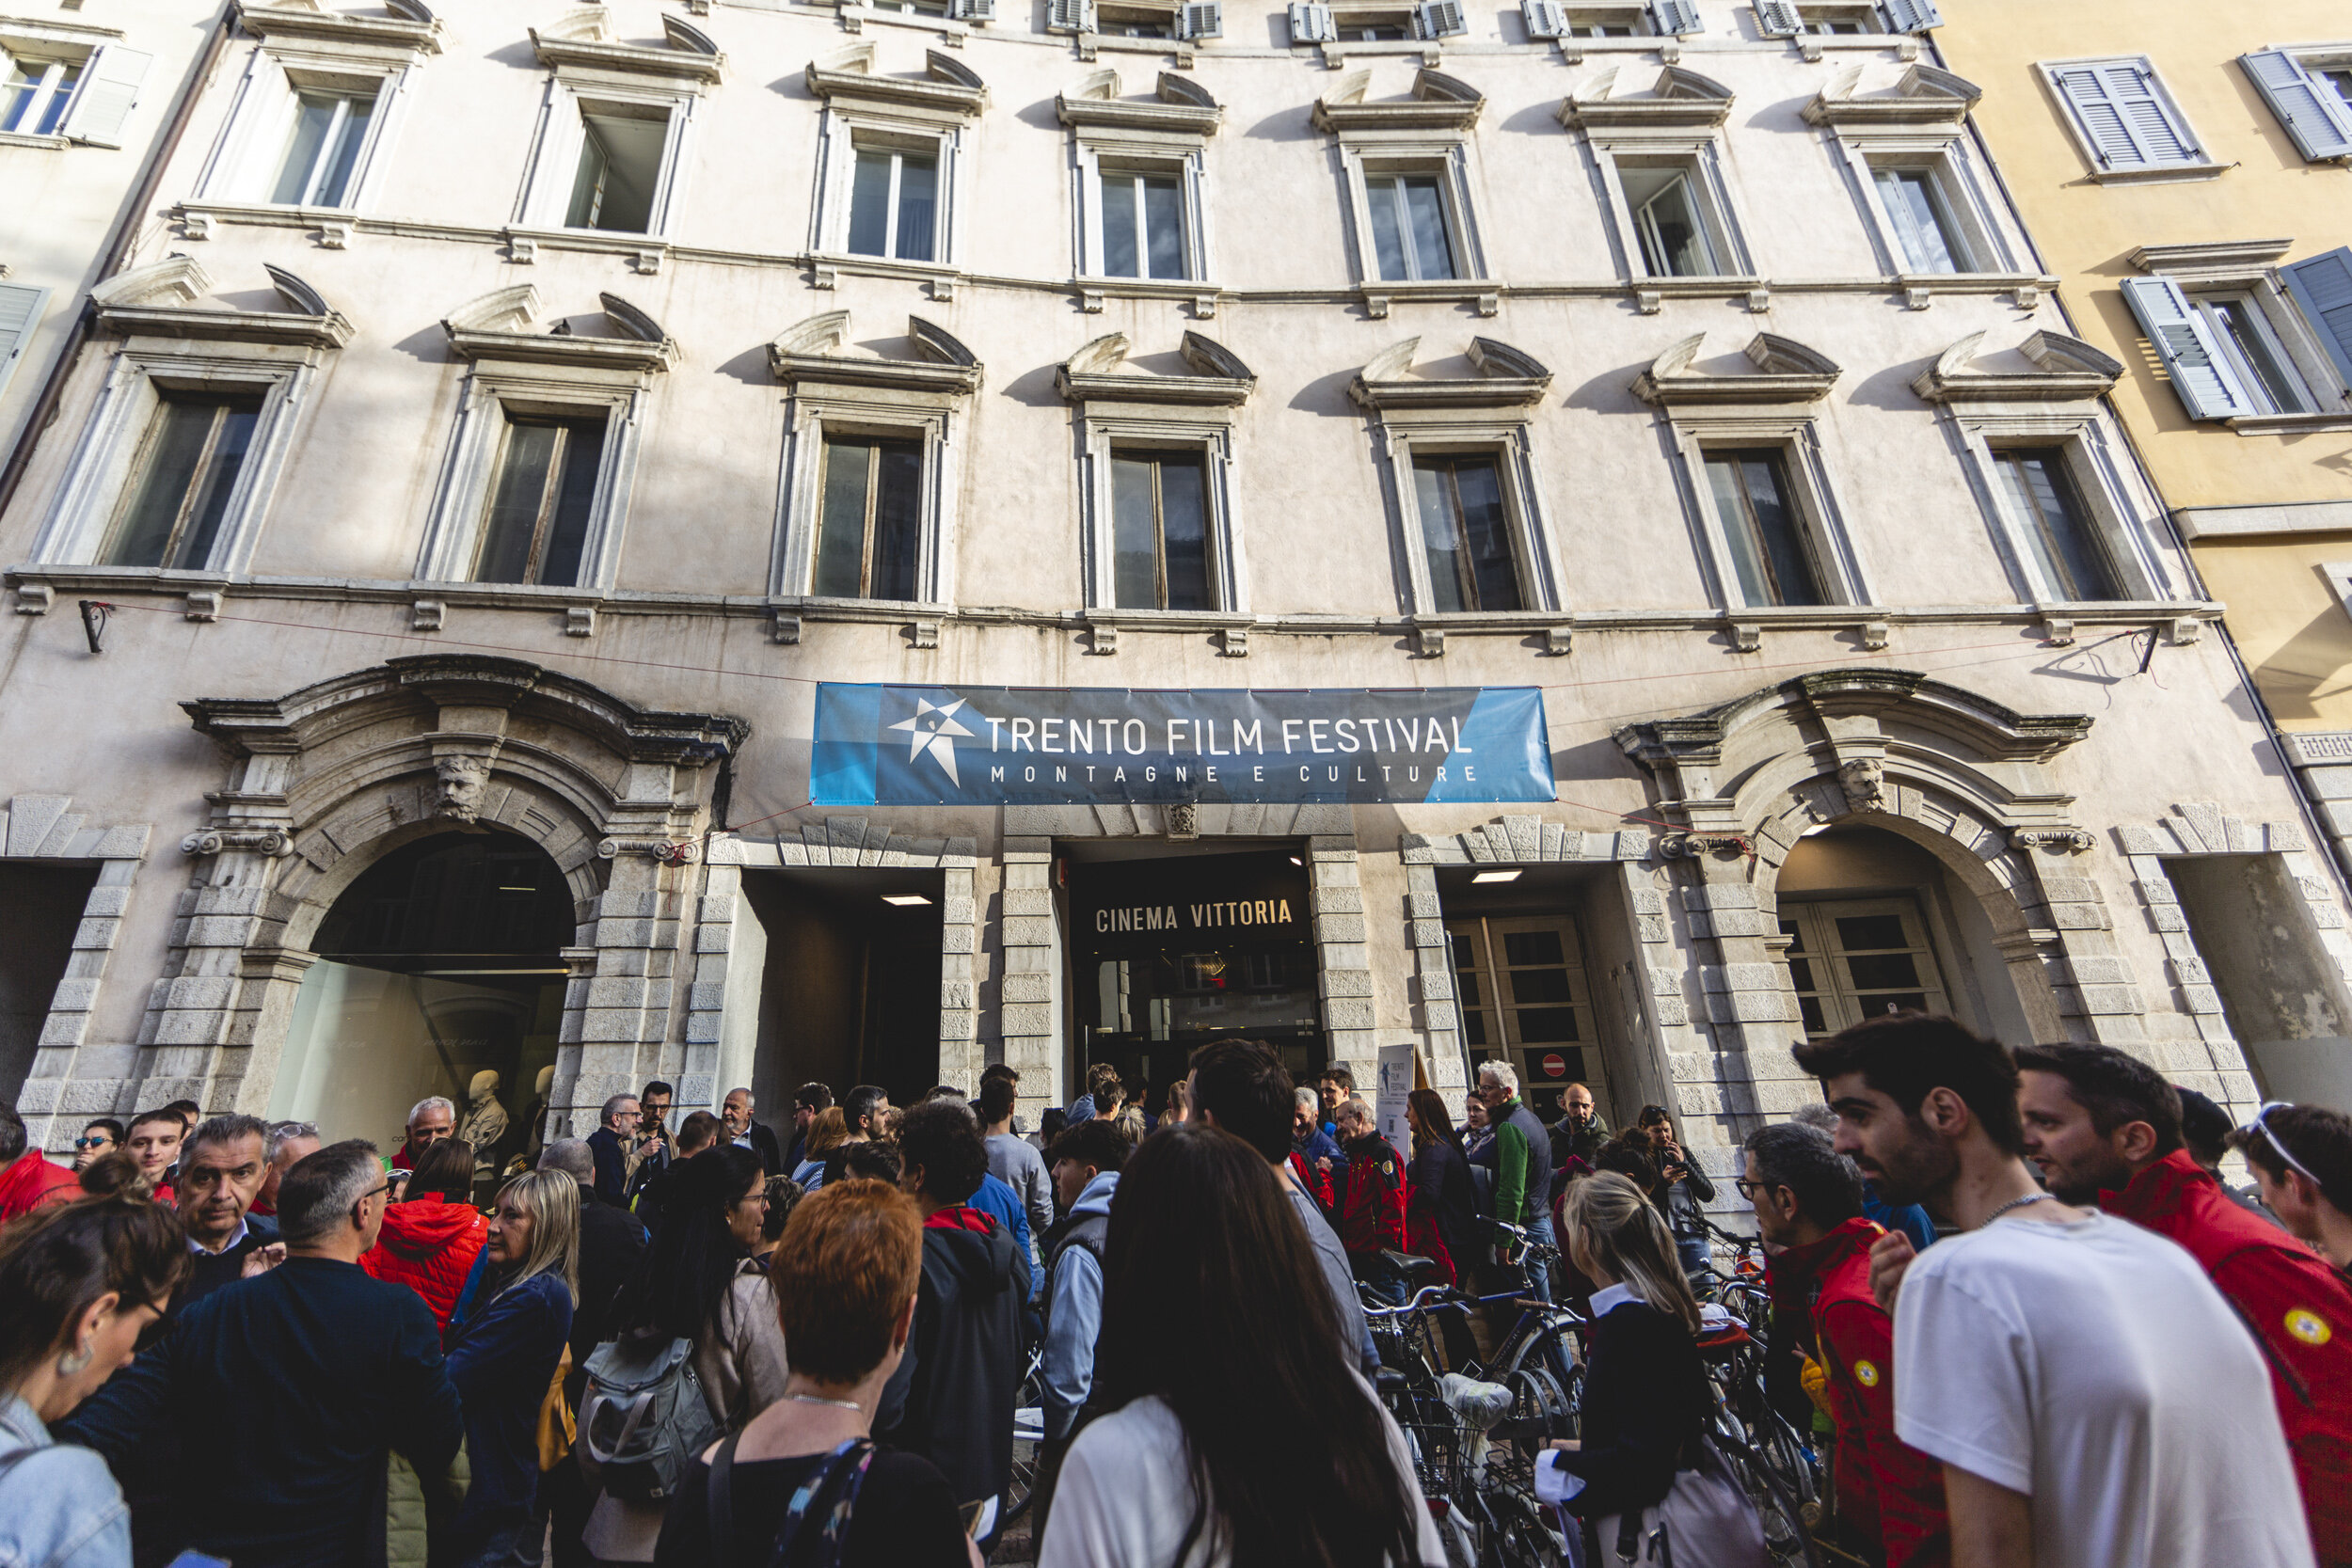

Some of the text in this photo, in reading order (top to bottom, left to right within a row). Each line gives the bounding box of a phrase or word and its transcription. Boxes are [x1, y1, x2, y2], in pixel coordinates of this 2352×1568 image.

[984, 716, 1473, 756] TRENTO FILM FESTIVAL
[990, 764, 1477, 784] MONTAGNE E CULTURE
[1095, 898, 1294, 934] CINEMA VITTORIA
[1391, 1062, 1406, 1071] TRENTO
[1391, 1072, 1400, 1082] FILM
[1391, 1083, 1407, 1092] FESTIVAL
